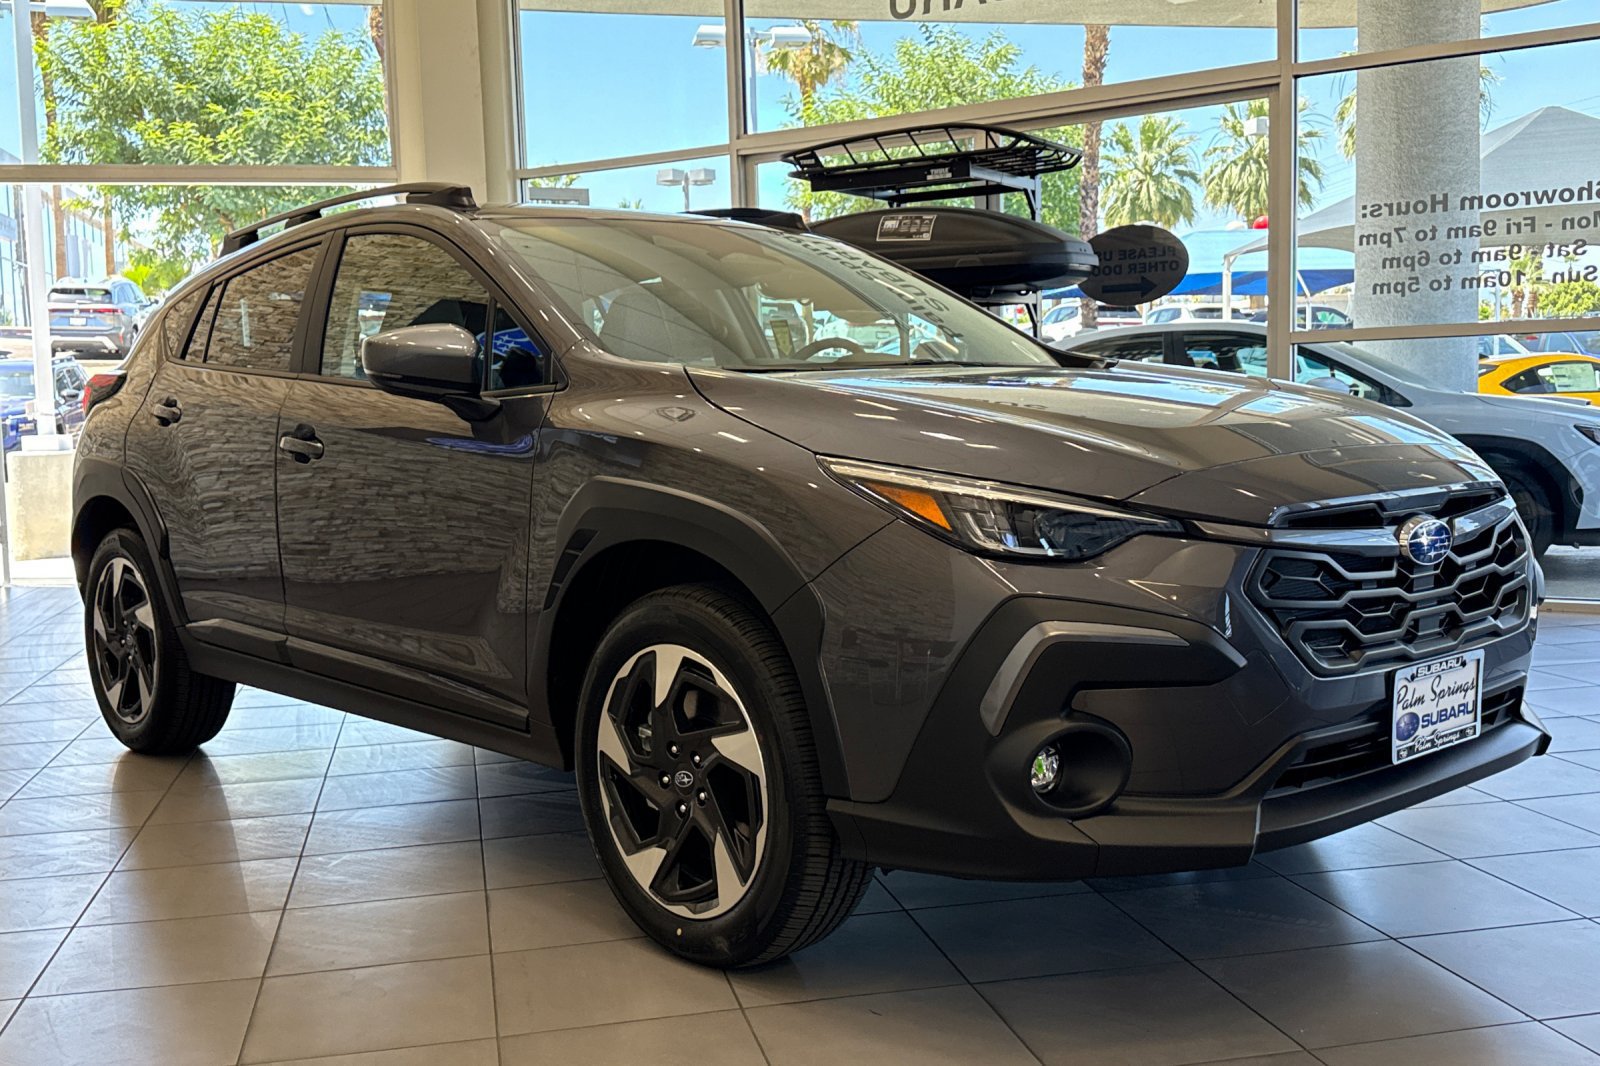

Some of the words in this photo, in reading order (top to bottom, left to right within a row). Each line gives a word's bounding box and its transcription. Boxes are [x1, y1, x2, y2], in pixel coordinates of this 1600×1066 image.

[1417, 656, 1462, 677] SUBARU
[1397, 684, 1425, 710] Palm
[1430, 675, 1476, 707] Springs
[1421, 700, 1475, 729] SUBARU
[1414, 735, 1432, 753] Palm
[1434, 729, 1460, 748] Springs
